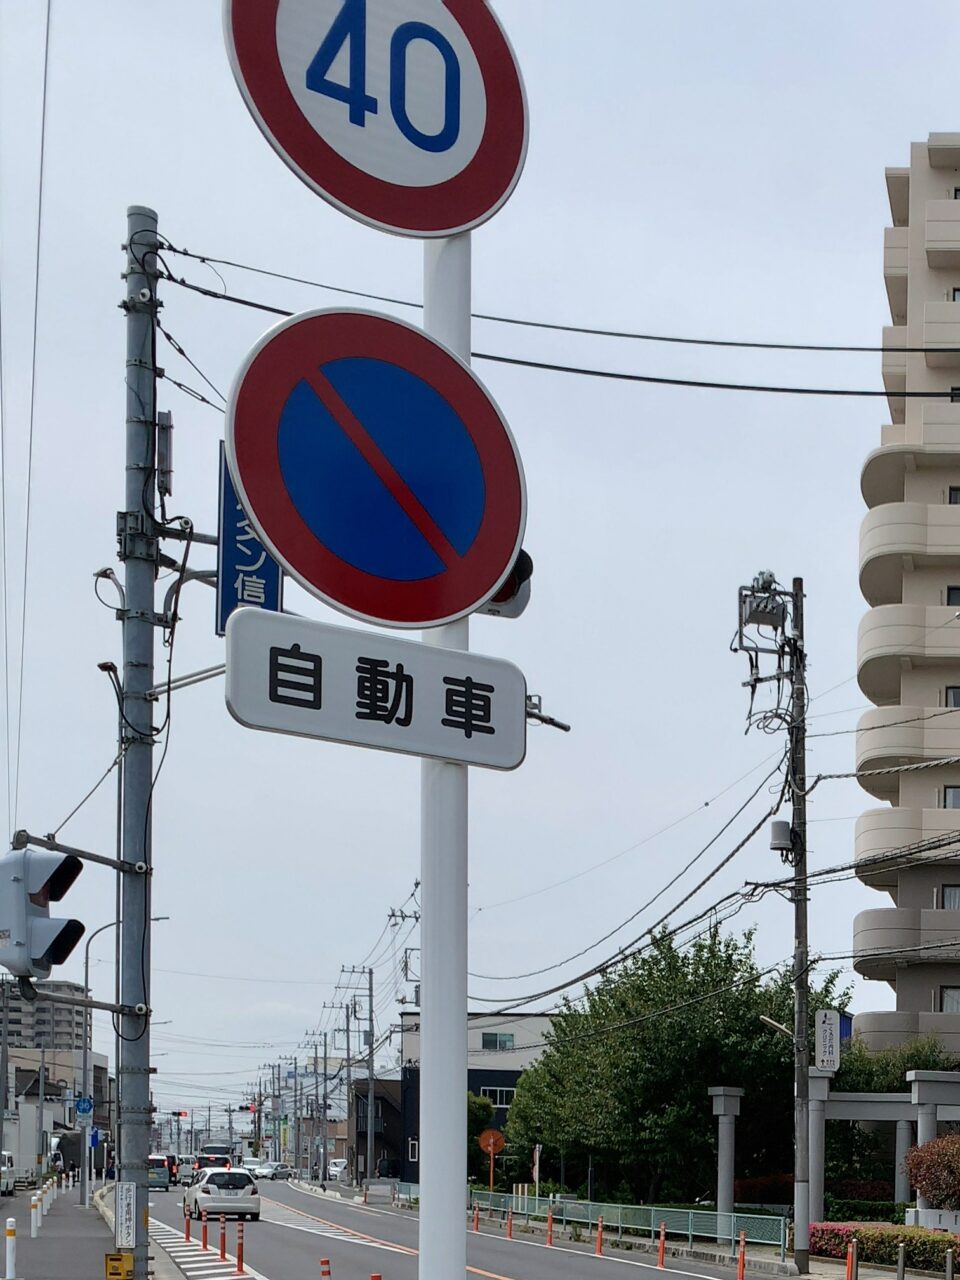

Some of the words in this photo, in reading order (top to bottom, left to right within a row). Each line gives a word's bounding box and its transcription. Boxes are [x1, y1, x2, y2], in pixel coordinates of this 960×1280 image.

[305, 0, 461, 153] 40
[268, 643, 496, 739] 自動車
